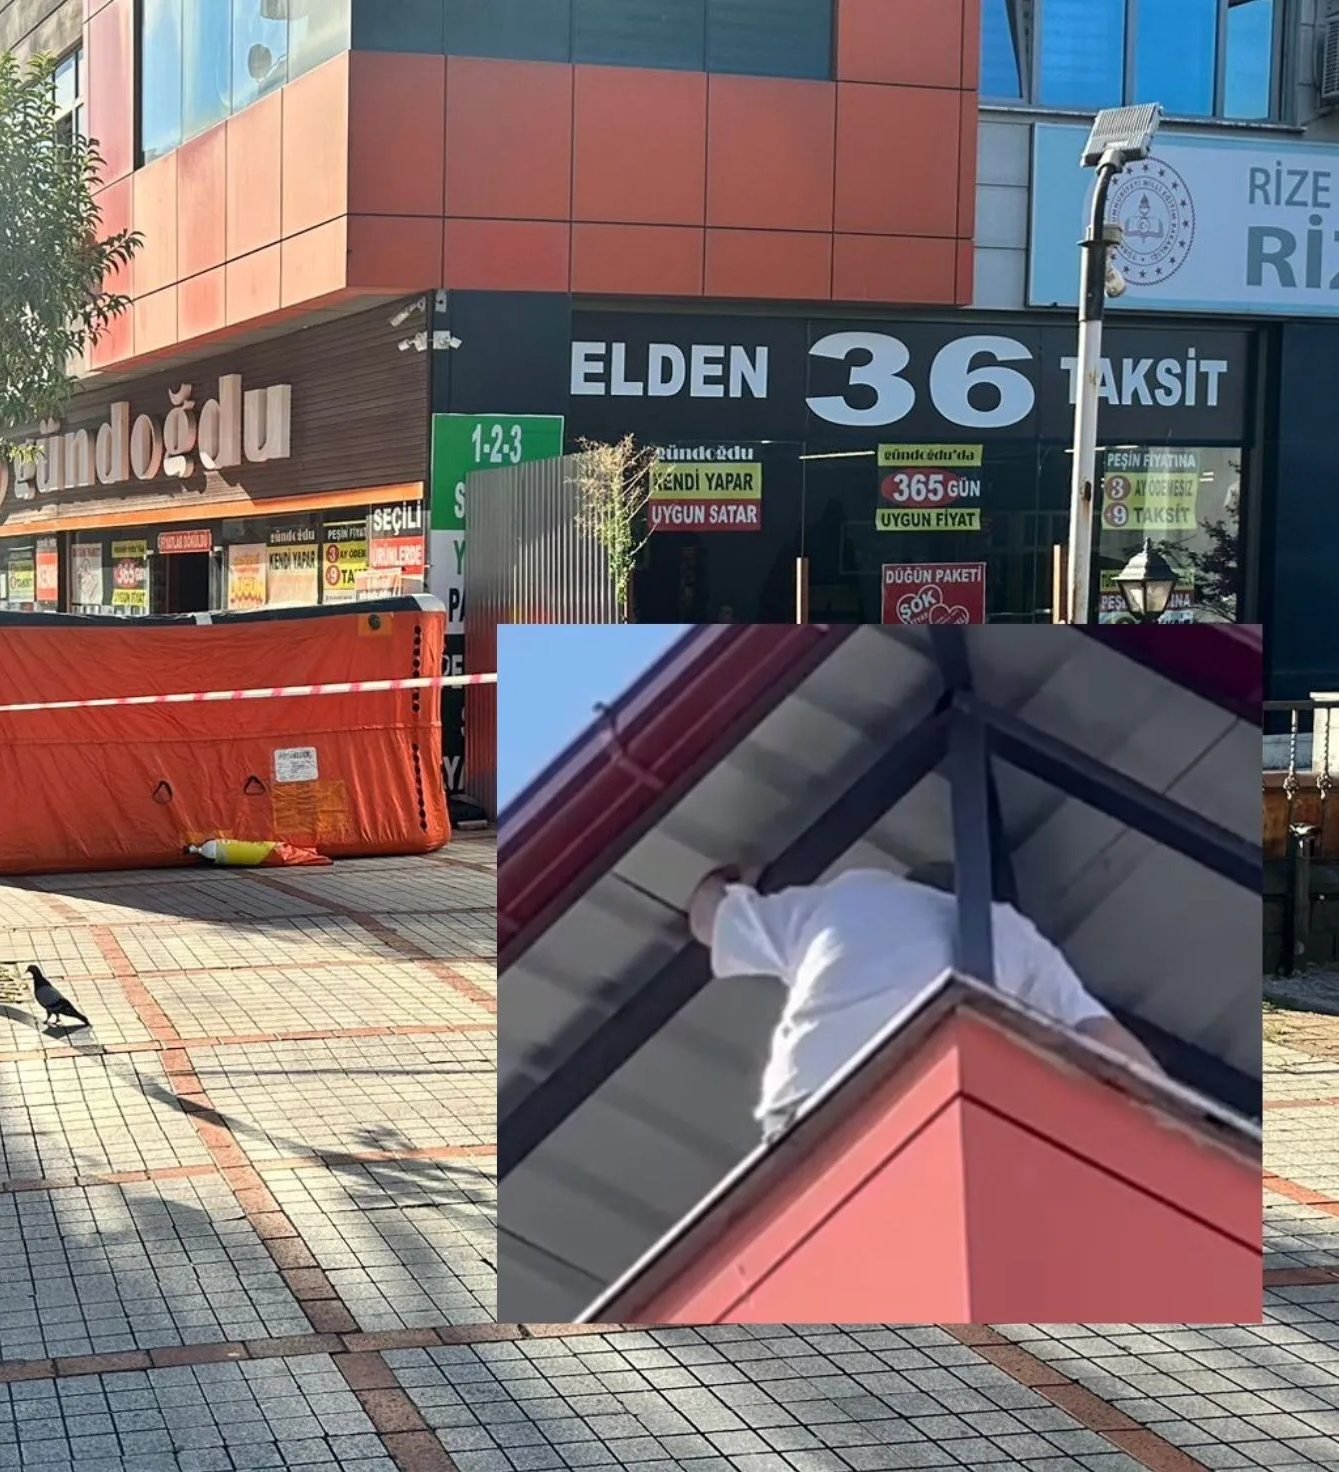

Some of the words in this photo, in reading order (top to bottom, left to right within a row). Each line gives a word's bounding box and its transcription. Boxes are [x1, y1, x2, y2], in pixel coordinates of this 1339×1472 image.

[1248, 160, 1331, 209] RİZE
[1246, 213, 1339, 290] Rİ
[570, 340, 769, 399] ELDEN
[805, 331, 1035, 429] 36
[1060, 347, 1228, 407] TAKSİT
[13, 373, 292, 500] gündoğdu
[471, 423, 522, 464] 1-2-3
[1107, 451, 1141, 470] PEŞİN
[1143, 451, 1196, 468] FİYATINA
[653, 468, 700, 491] KENDİ
[705, 472, 754, 491] YAPAR
[892, 473, 944, 502] 365
[947, 477, 981, 497] GÜN
[1111, 478, 1124, 499] 3
[373, 500, 421, 536] SEÇİLİ
[651, 504, 705, 524] UYGUN
[709, 504, 758, 524] SATAR
[881, 511, 931, 527] UYGUN
[936, 508, 976, 527] FİYAT
[1133, 503, 1190, 524] TAKSİT
[327, 527, 348, 541] PEŞİN
[269, 548, 291, 570] KENDİ
[292, 549, 315, 570] YAPAR
[372, 542, 422, 567] ÜRÜNLERDE
[886, 567, 931, 584] DÜĞÜN
[936, 565, 981, 583] PAKETİ
[900, 589, 937, 621] ŞOK
